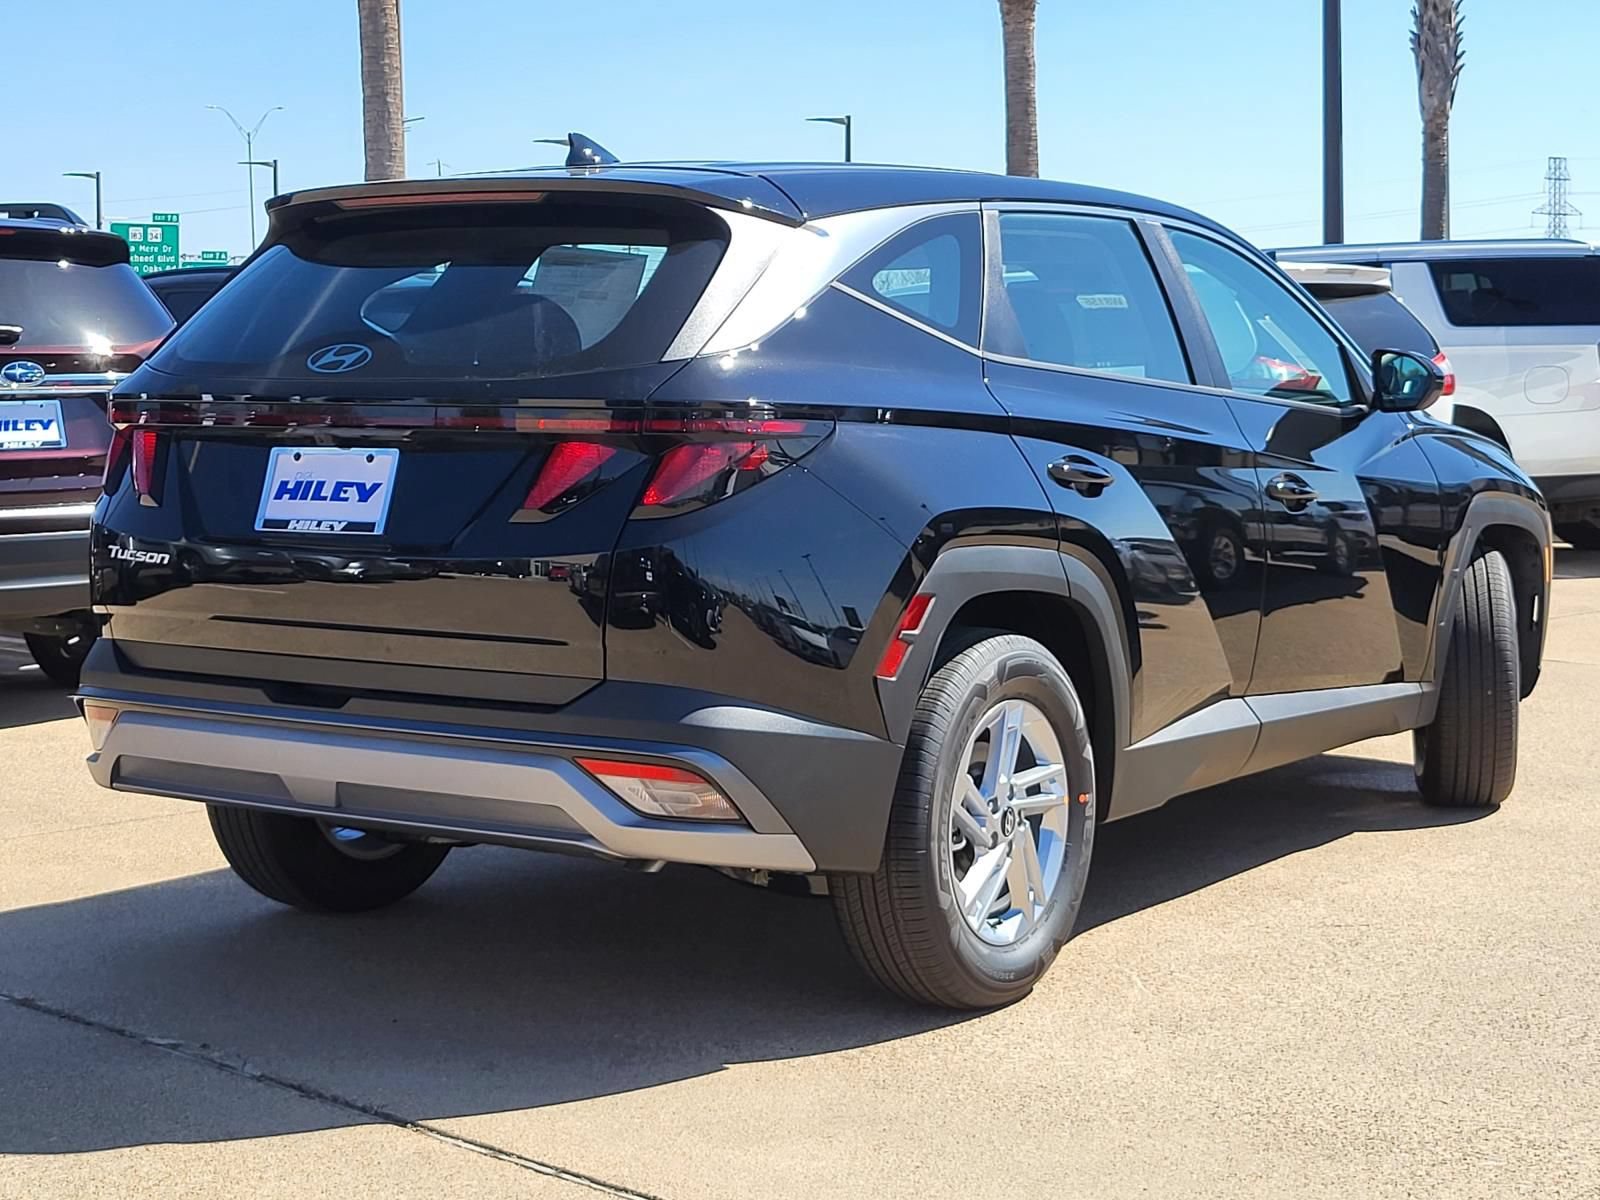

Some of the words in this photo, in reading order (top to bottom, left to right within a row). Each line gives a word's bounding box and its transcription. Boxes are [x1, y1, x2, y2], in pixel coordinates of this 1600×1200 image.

[131, 232, 142, 240] 183
[149, 232, 162, 240] 341
[139, 244, 158, 252] Mere
[162, 244, 172, 252] Dr
[157, 254, 175, 262] Blvd
[0, 419, 55, 431] ILEY
[273, 480, 383, 502] HILEY
[287, 519, 348, 531] HILEY
[107, 544, 171, 565] Tucson
